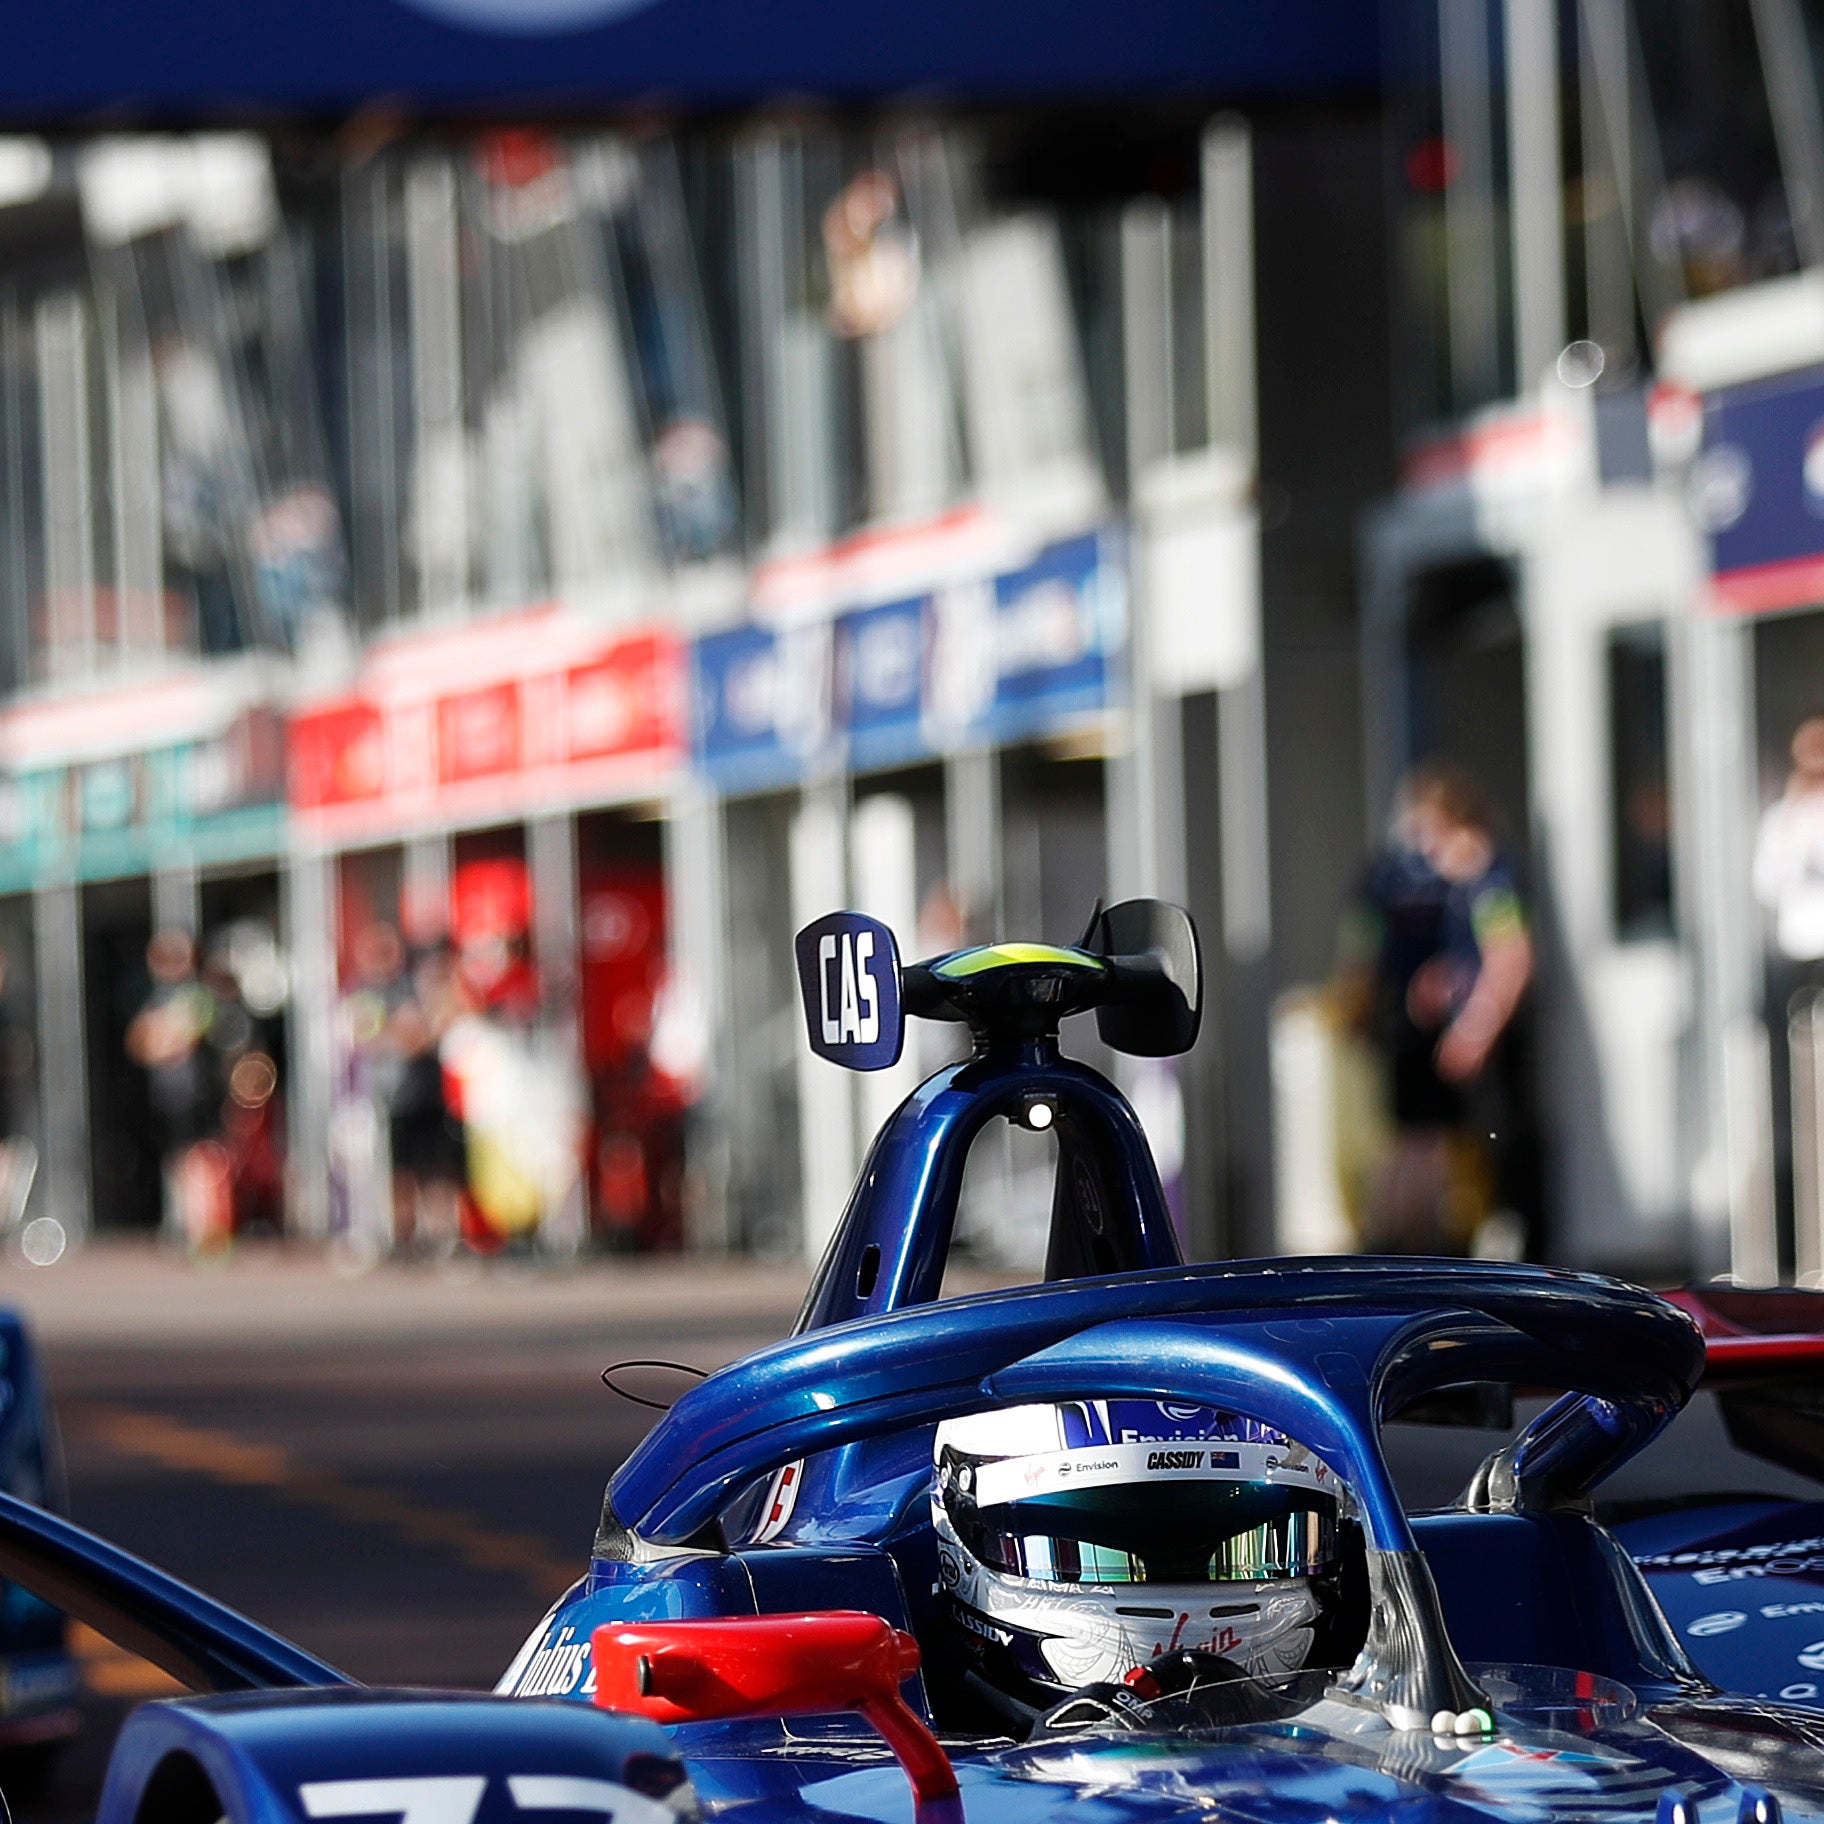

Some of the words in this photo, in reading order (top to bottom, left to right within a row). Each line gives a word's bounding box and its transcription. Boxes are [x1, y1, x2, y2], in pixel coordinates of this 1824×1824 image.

[818, 931, 880, 1045] CAS
[1076, 1461, 1118, 1473] Envision
[1147, 1451, 1205, 1470] CASSIDY
[952, 1603, 1015, 1647] CASSIDY
[1115, 1690, 1154, 1723] OMP
